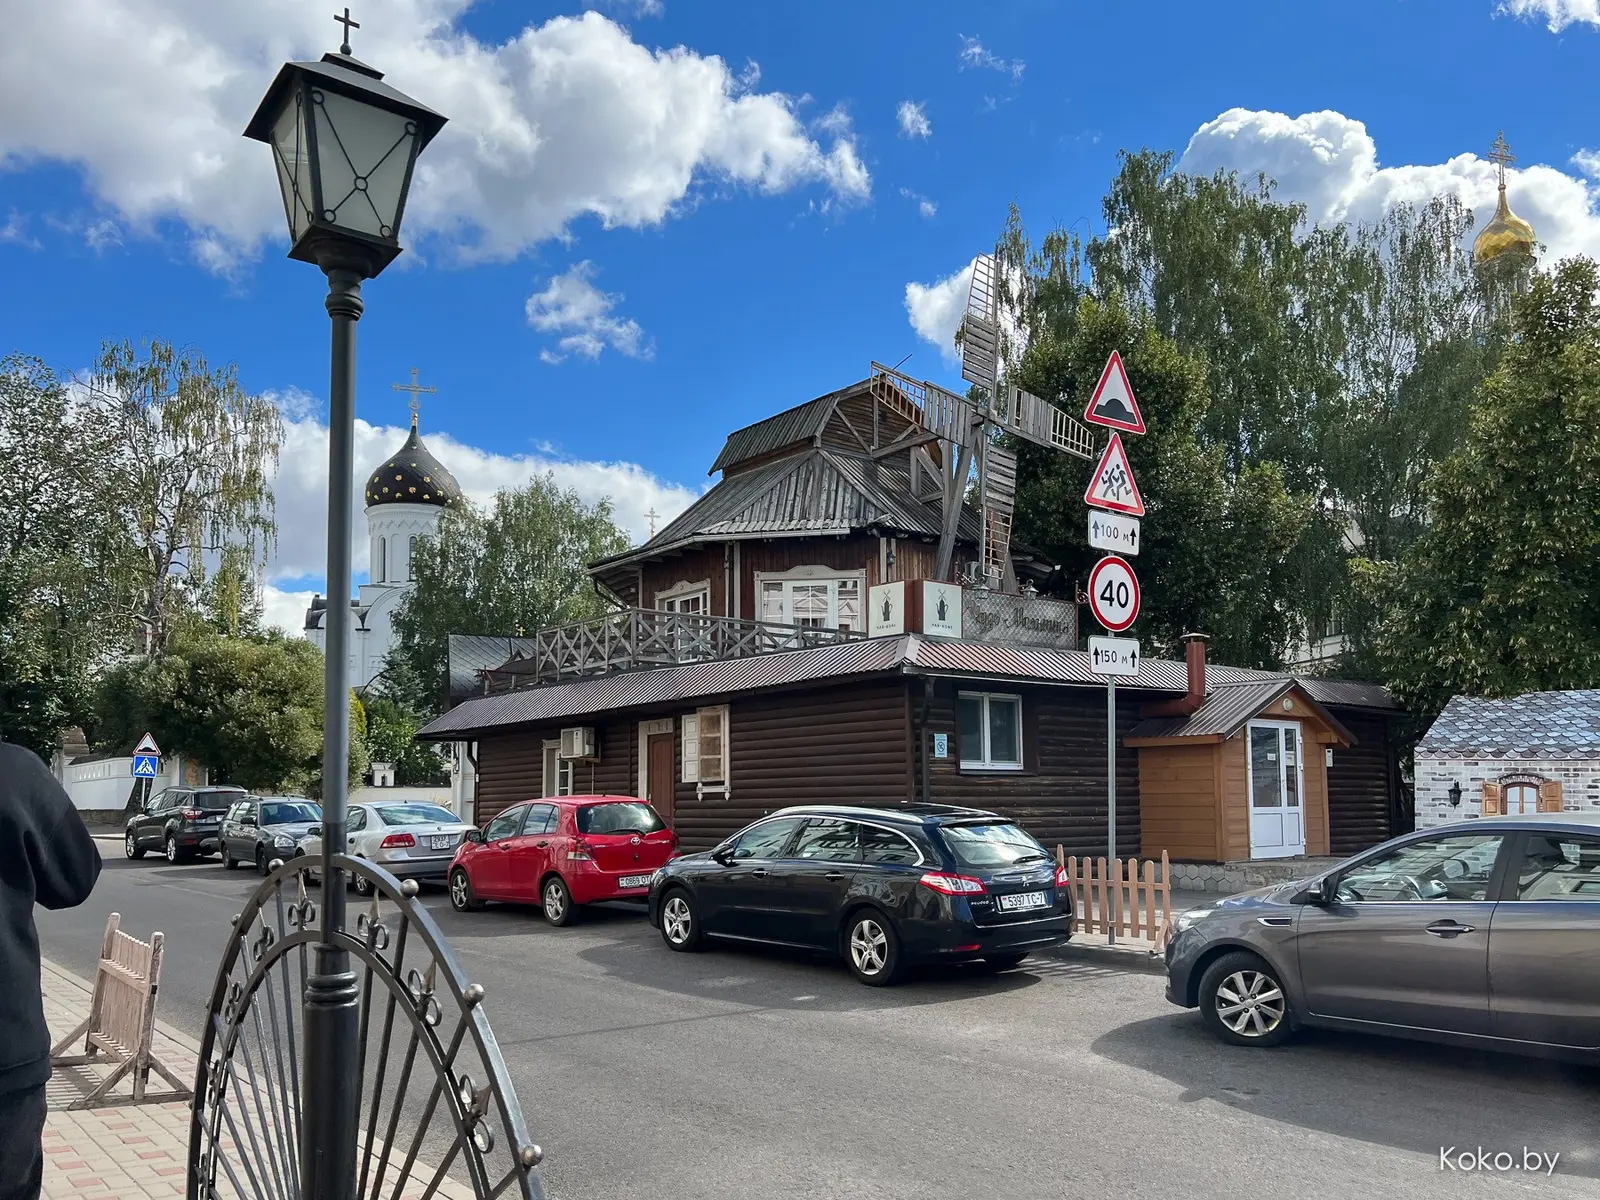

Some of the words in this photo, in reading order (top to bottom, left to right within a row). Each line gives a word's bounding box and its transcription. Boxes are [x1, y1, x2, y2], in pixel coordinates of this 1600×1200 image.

[1101, 524, 1119, 539] 100
[1100, 579, 1129, 609] 40
[1100, 650, 1118, 663] 150
[1007, 894, 1025, 907] 5397
[1025, 892, 1043, 905] TC-7
